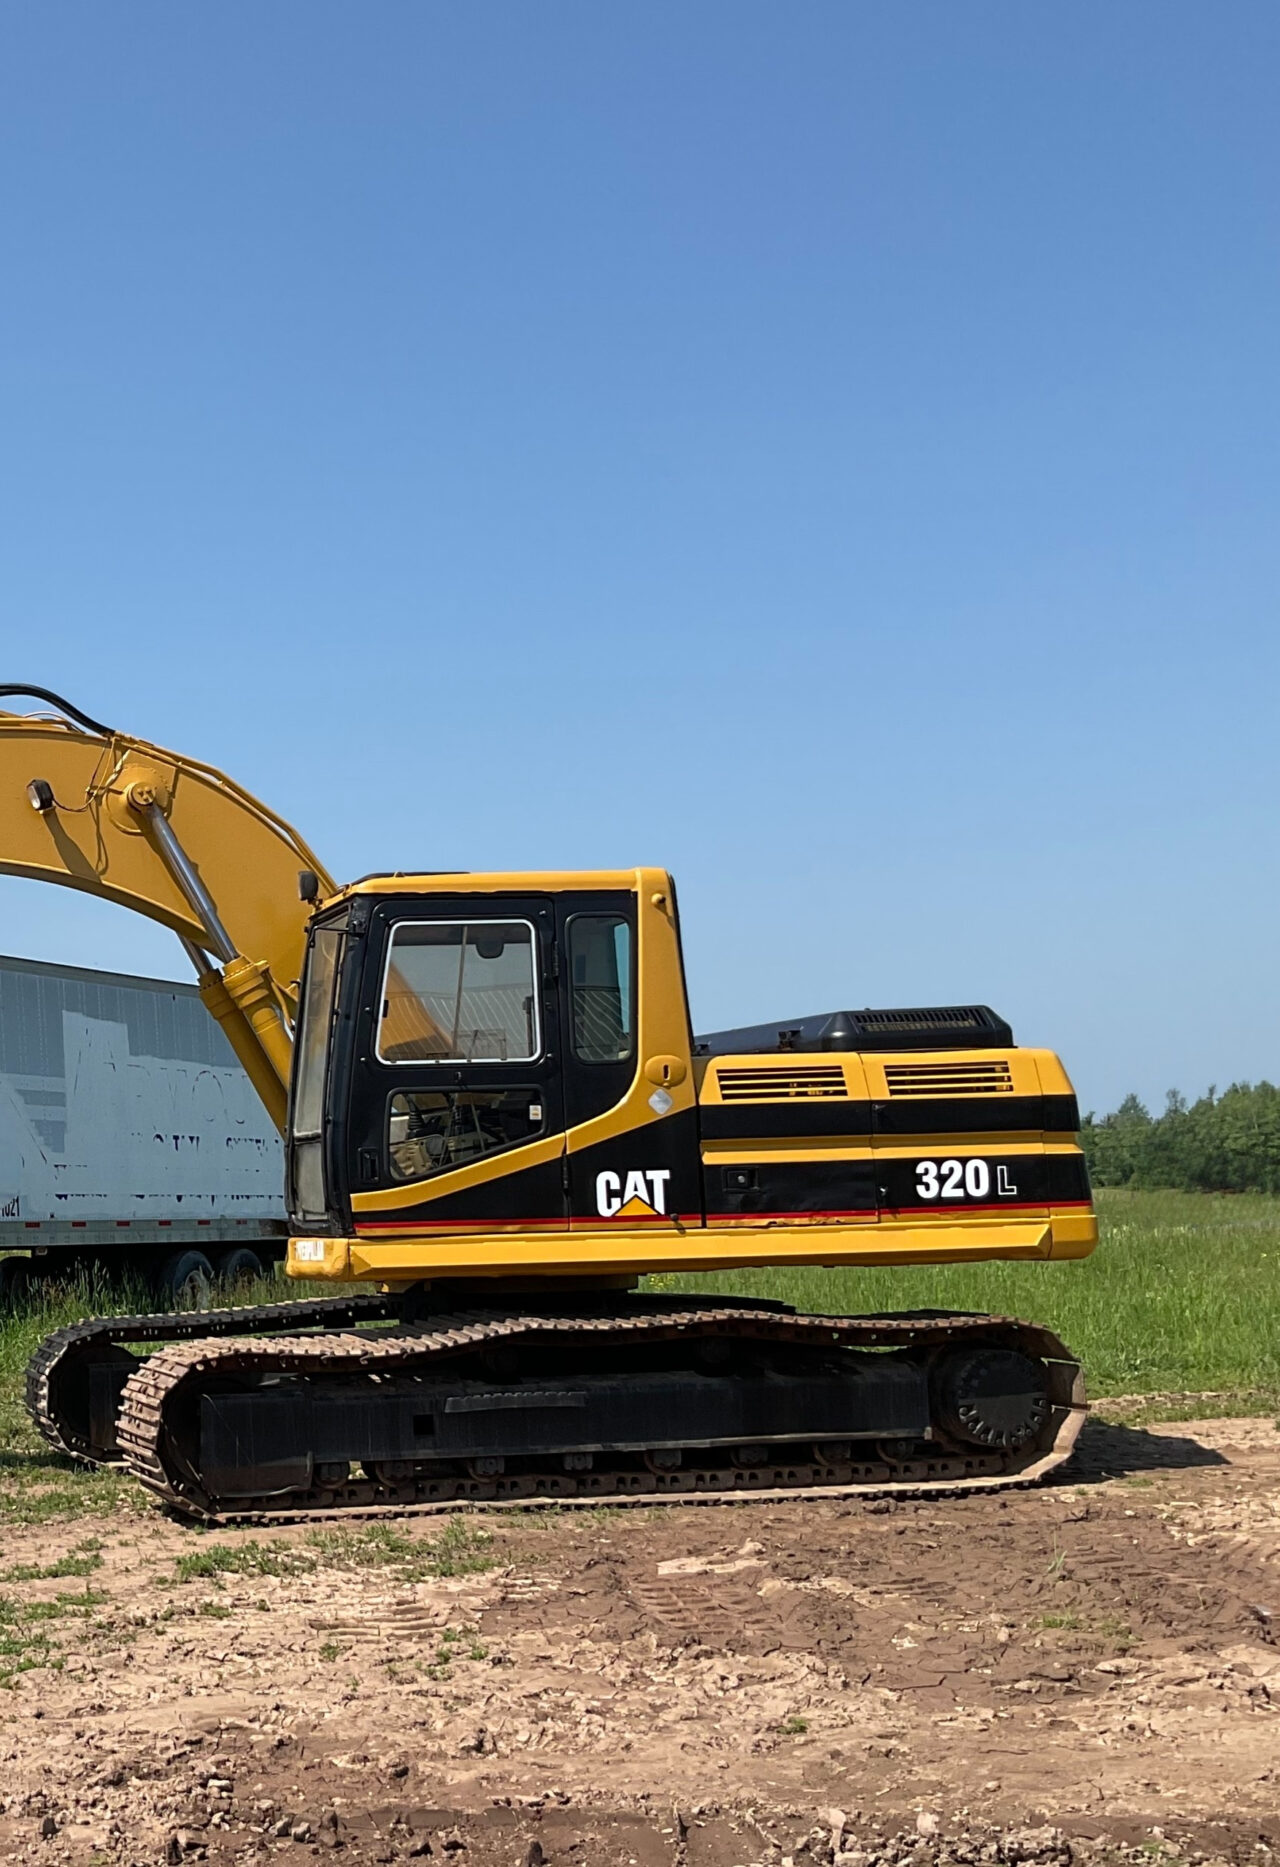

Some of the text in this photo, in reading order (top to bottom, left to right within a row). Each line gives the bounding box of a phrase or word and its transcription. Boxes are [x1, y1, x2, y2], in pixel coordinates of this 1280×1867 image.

[595, 1169, 670, 1218] CAT
[915, 1158, 1017, 1199] 320 L
